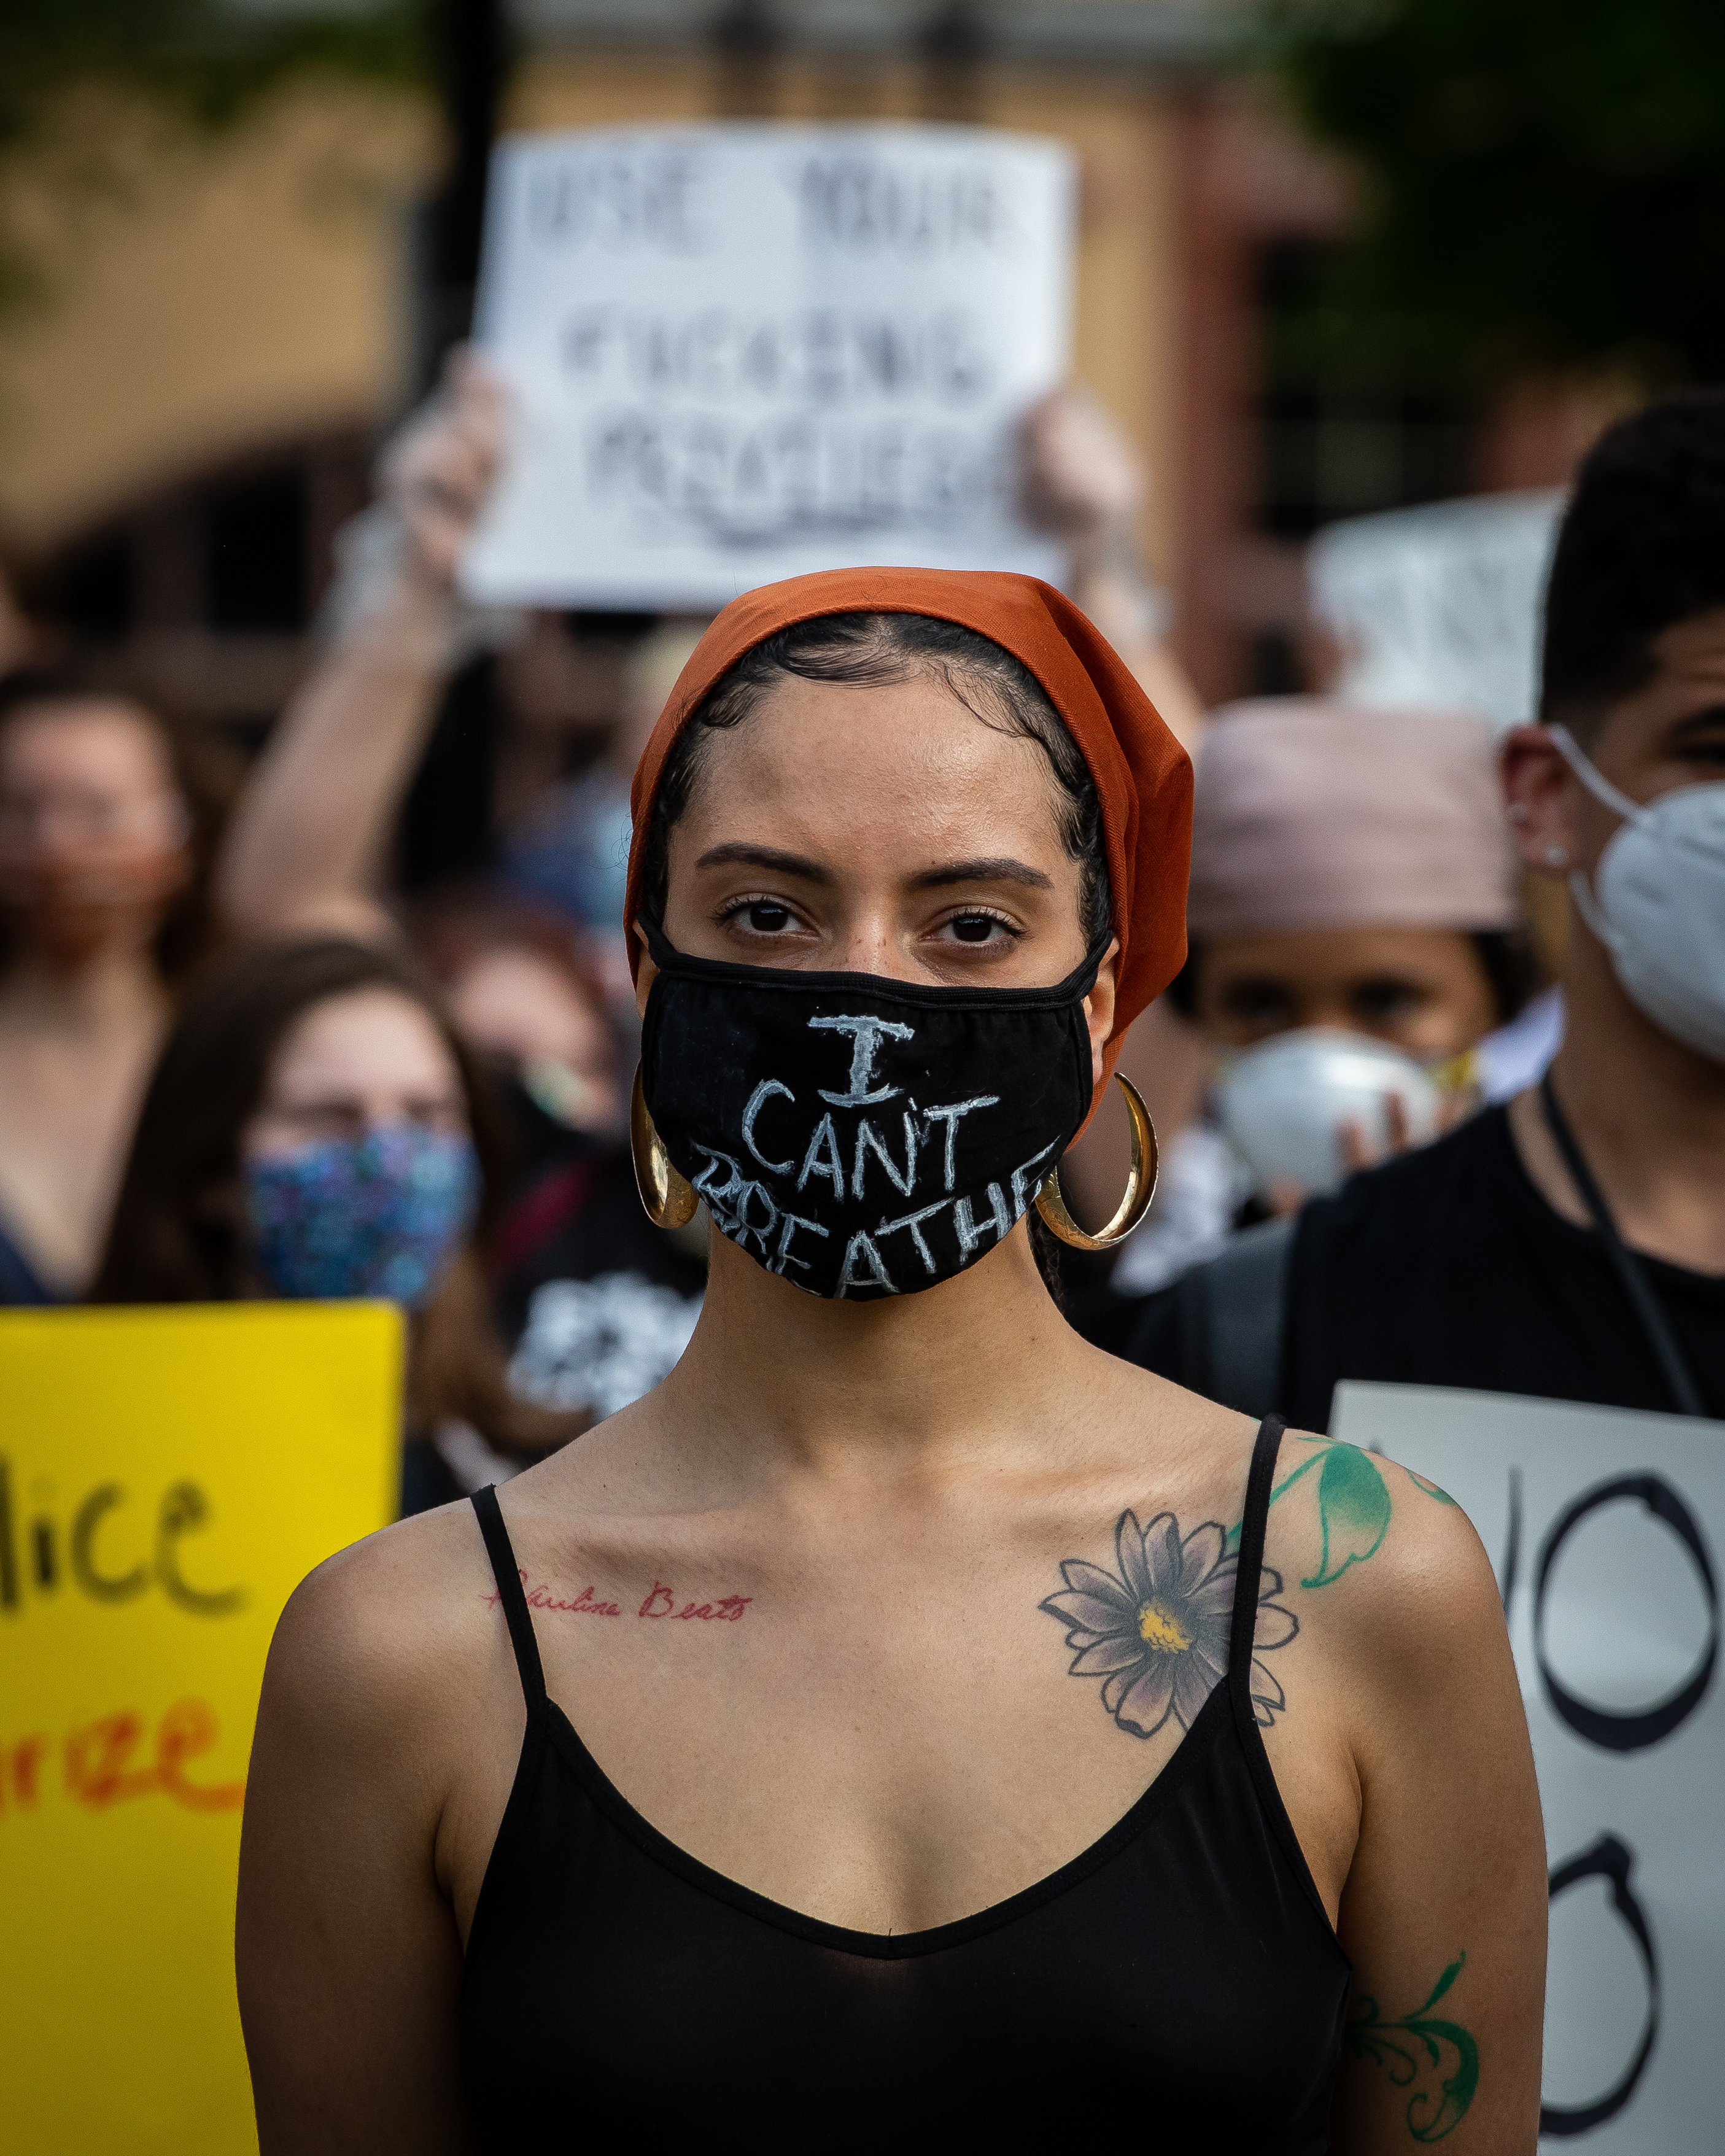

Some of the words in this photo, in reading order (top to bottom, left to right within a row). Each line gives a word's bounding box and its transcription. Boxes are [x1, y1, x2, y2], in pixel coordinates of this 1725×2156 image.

[525, 146, 712, 257] USE
[785, 152, 1008, 261] YOUR
[557, 304, 996, 408] FUCKING
[807, 1015, 915, 1107] I
[742, 1079, 1001, 1203] CAN'T
[1495, 1466, 1720, 1757] O
[0, 1697, 246, 1814] rize
